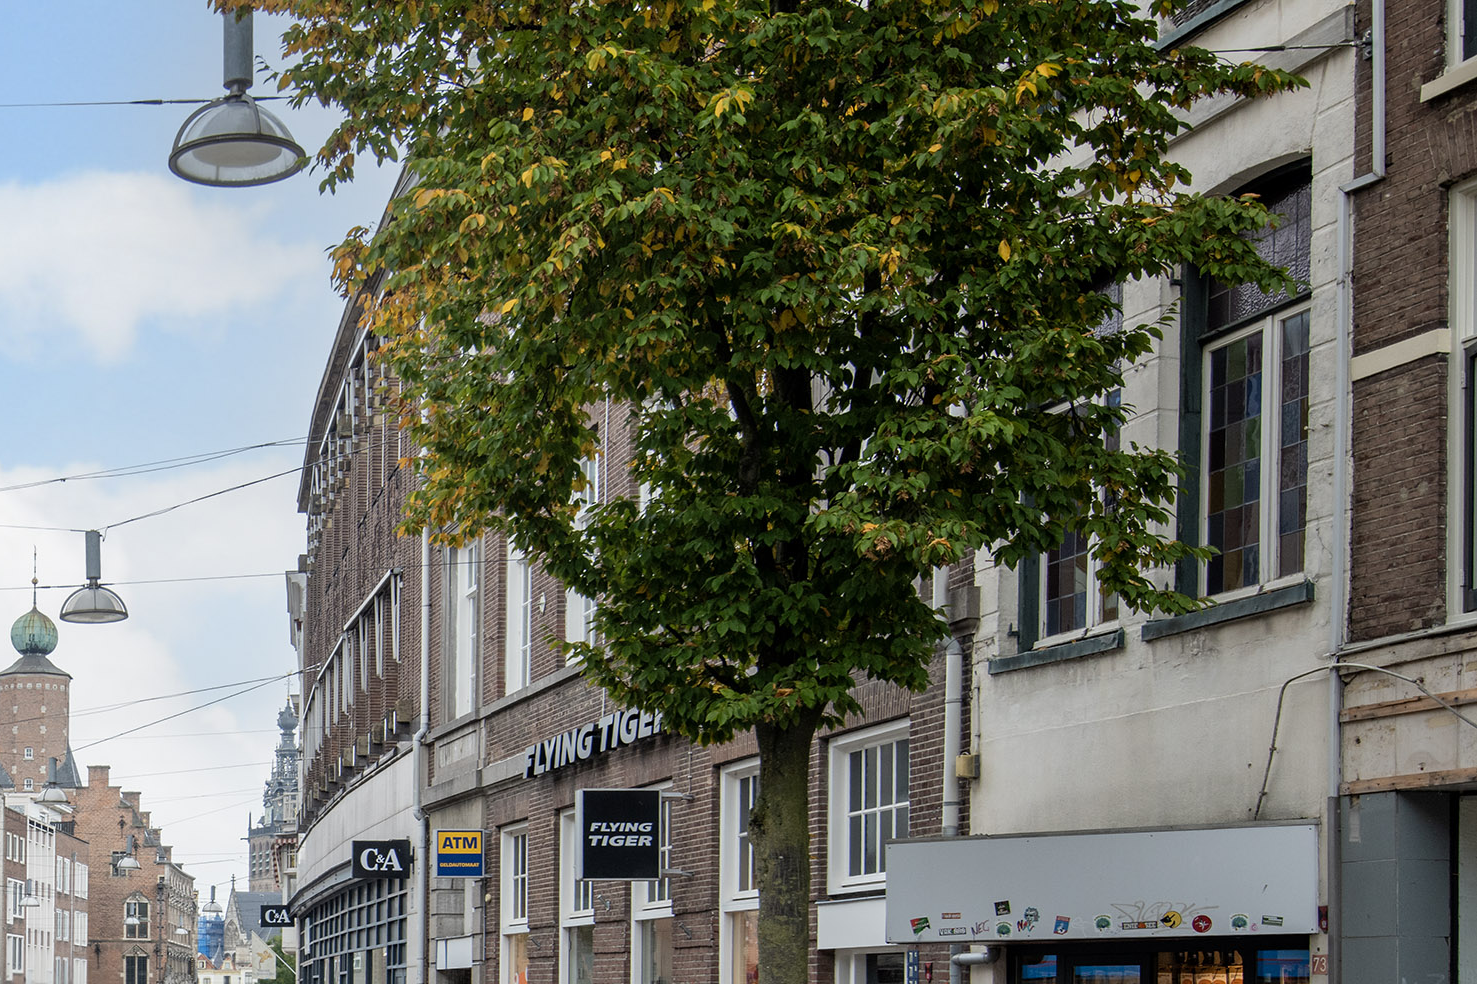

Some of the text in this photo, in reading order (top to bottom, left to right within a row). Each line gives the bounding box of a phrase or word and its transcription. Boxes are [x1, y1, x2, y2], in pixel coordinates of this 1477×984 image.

[522, 722, 595, 780] FLYING
[589, 822, 653, 832] FLYING
[441, 837, 478, 849] ATM
[588, 835, 653, 847] TIGER
[360, 847, 403, 872] C&A
[264, 909, 291, 924] C&A
[1313, 957, 1327, 972] 73
